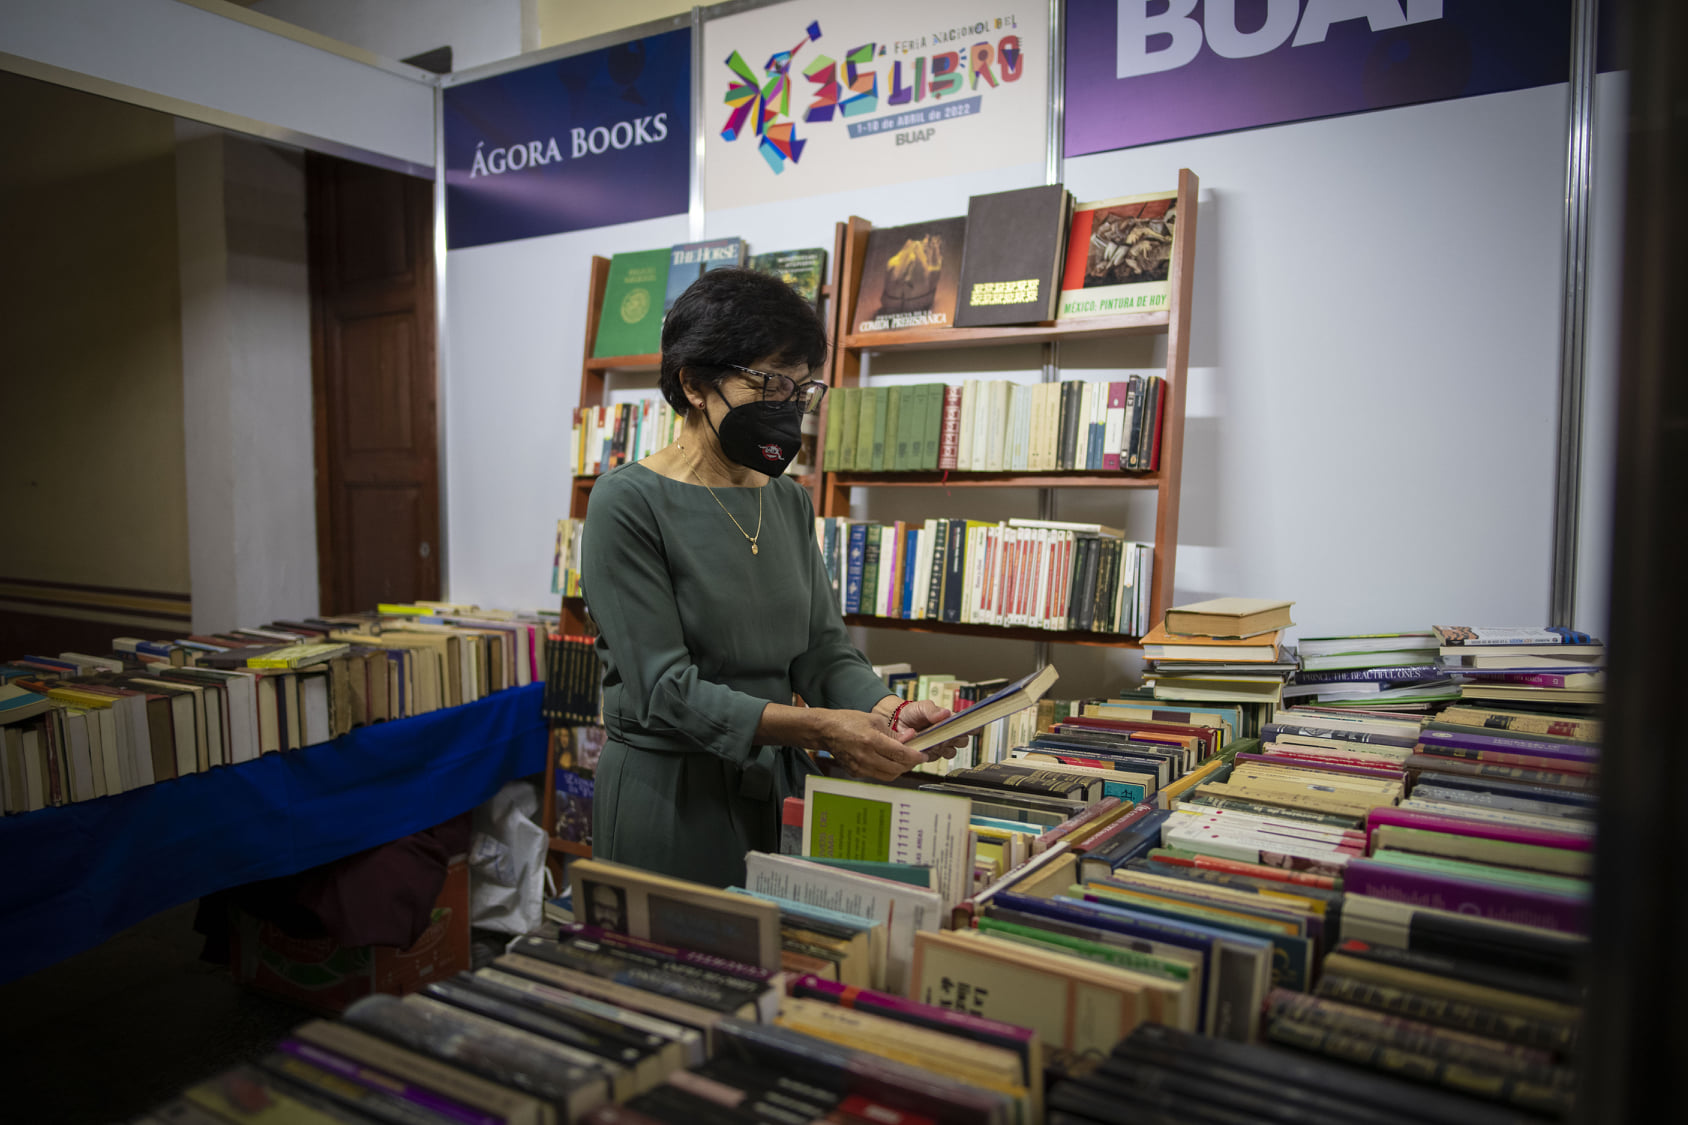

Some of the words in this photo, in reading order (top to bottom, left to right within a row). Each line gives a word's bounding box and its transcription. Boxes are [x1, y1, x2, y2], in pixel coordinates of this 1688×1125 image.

[1117, 0, 1443, 79] BU
[888, 35, 1024, 107] LIBRO
[897, 112, 925, 126] ABRIL
[944, 103, 971, 118] 2022
[469, 137, 563, 178] ÁGORA
[570, 112, 669, 159] BOOKS
[895, 128, 936, 146] BUAP
[672, 248, 698, 265] THE
[698, 243, 740, 263] HORSE
[1099, 296, 1134, 311] PINTURA
[1136, 295, 1148, 307] DE
[1149, 294, 1168, 306] HOY
[1351, 669, 1396, 680] BEAUTIFUL
